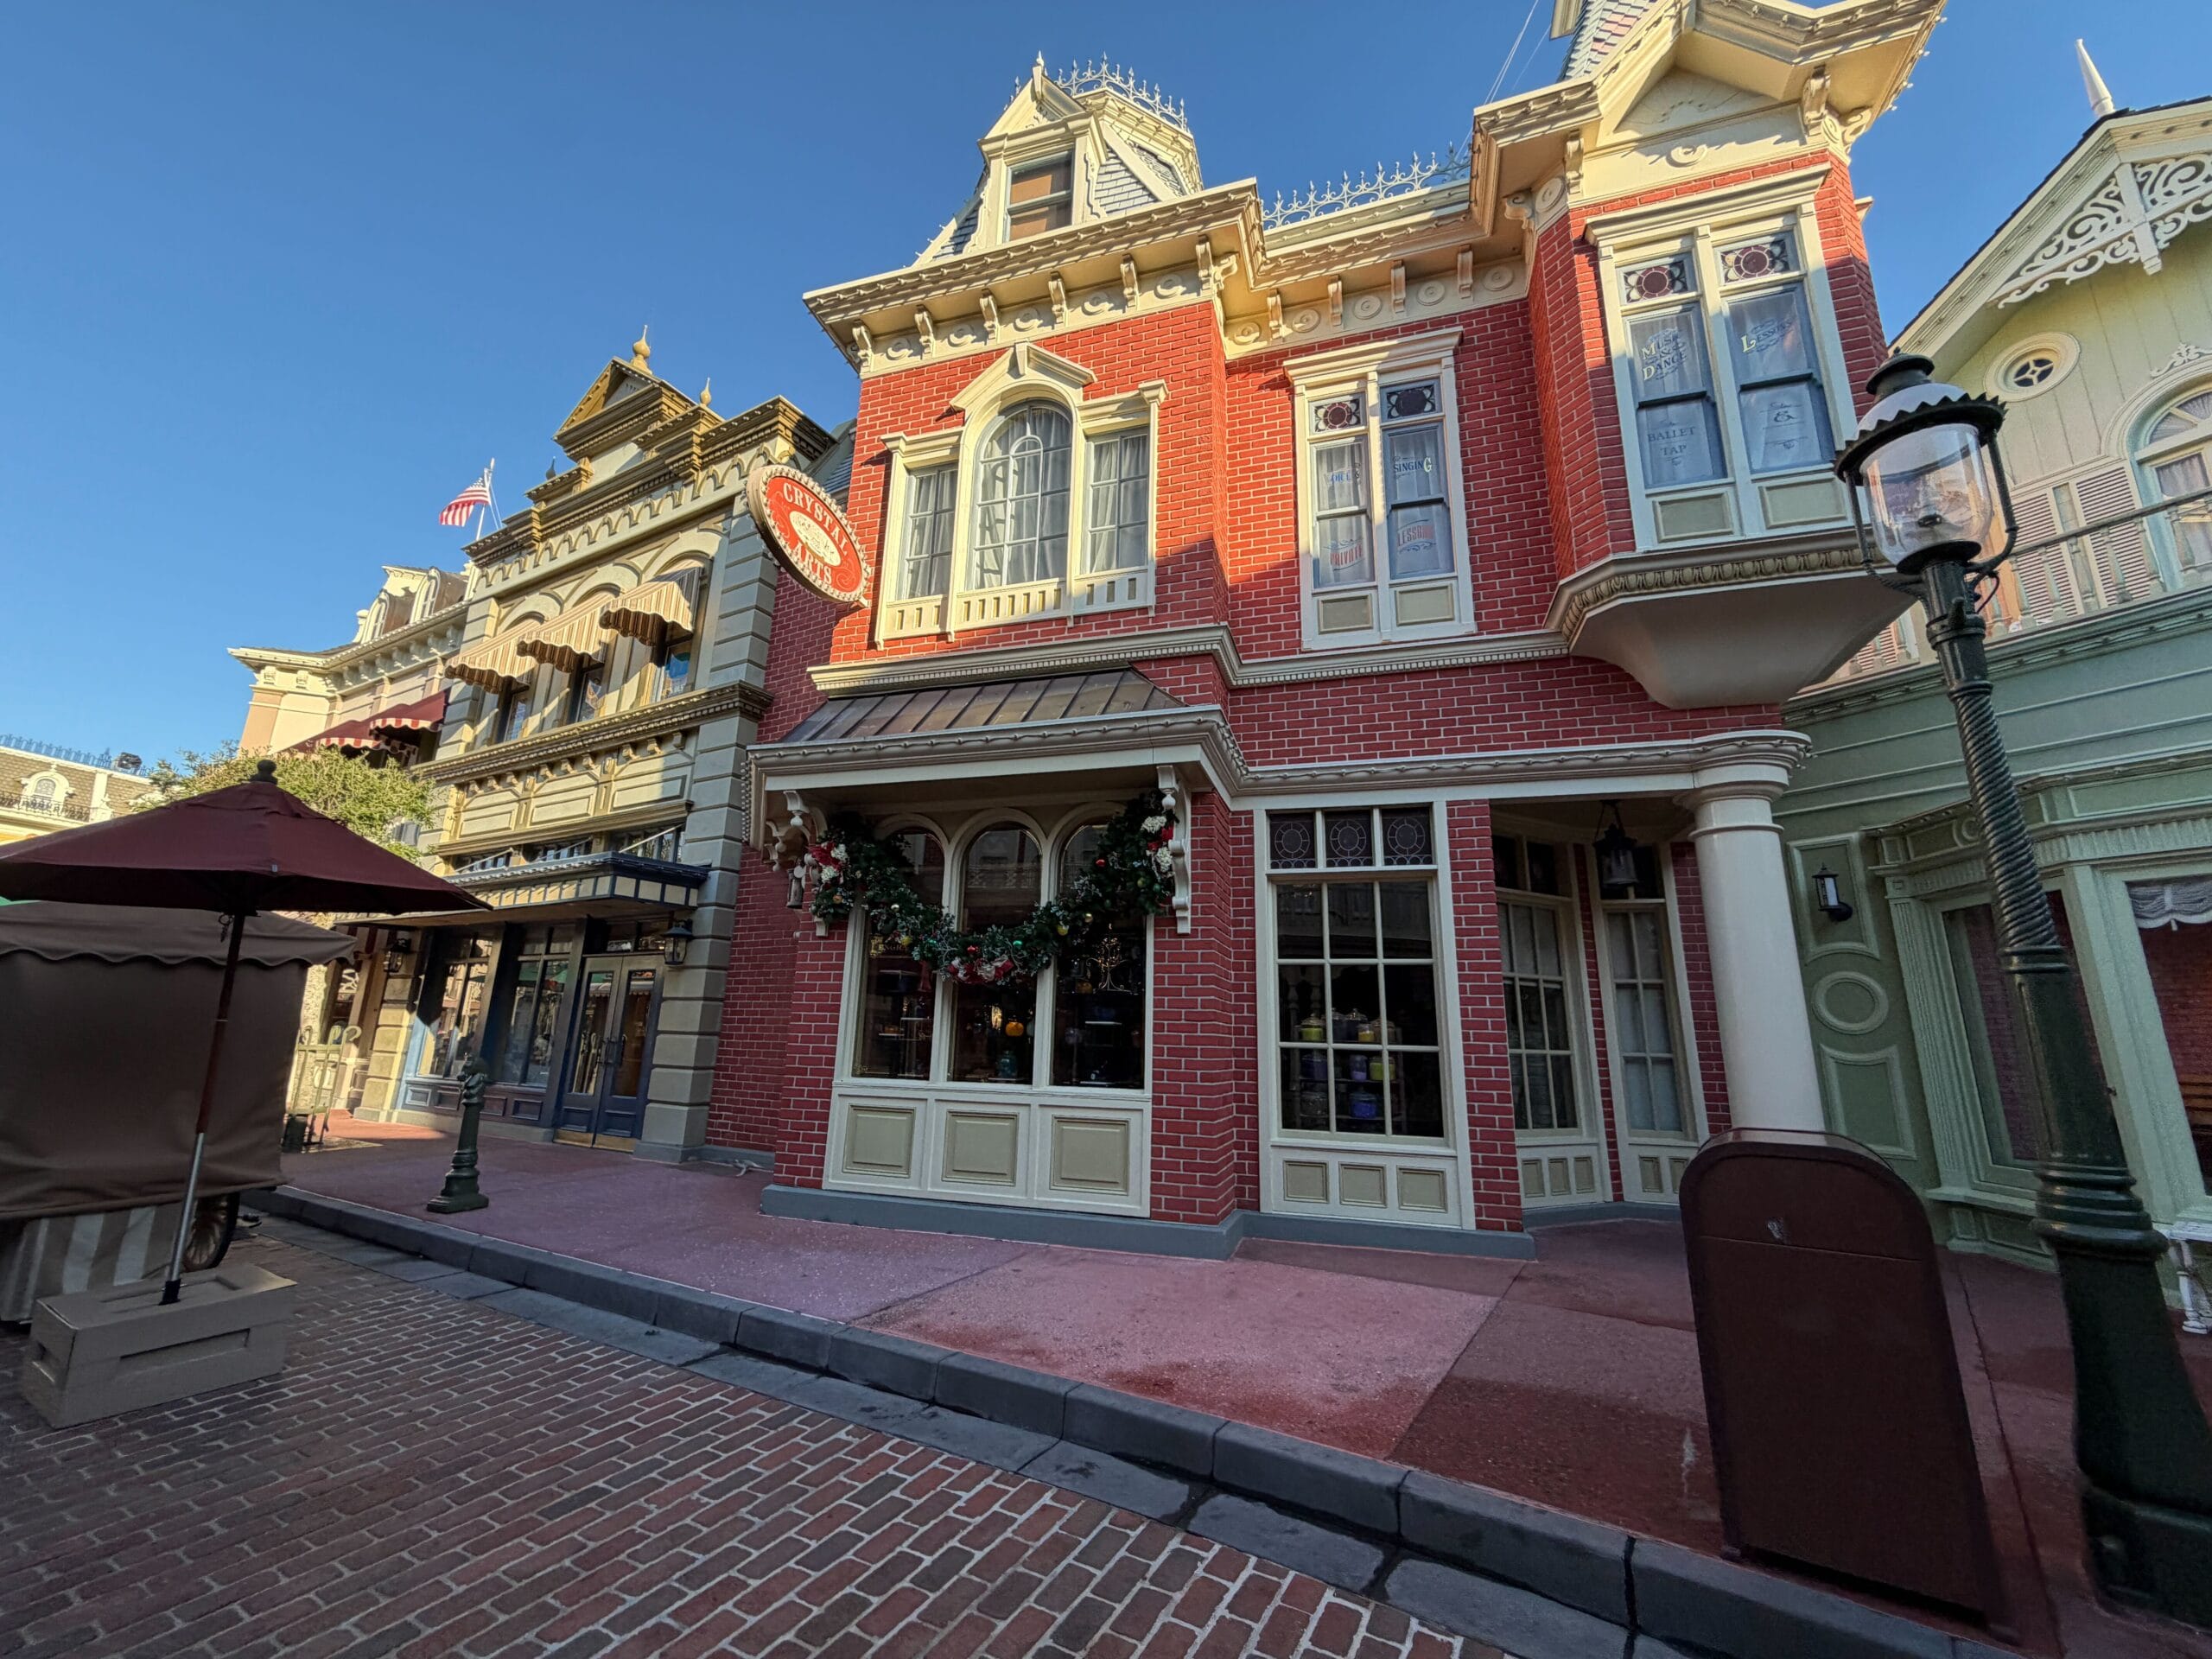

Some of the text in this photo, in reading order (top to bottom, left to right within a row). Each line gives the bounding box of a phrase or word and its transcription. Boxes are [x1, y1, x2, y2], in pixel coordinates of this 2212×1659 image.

[1642, 349, 1688, 381] DANCE
[1774, 410, 1798, 423] &
[1647, 425, 1696, 442] BALLET
[1660, 443, 1688, 455] TAP
[1393, 456, 1433, 474] SINGING
[782, 482, 849, 556] CRYSTAL
[1396, 524, 1435, 547] LESSO
[794, 543, 834, 586] ARTS
